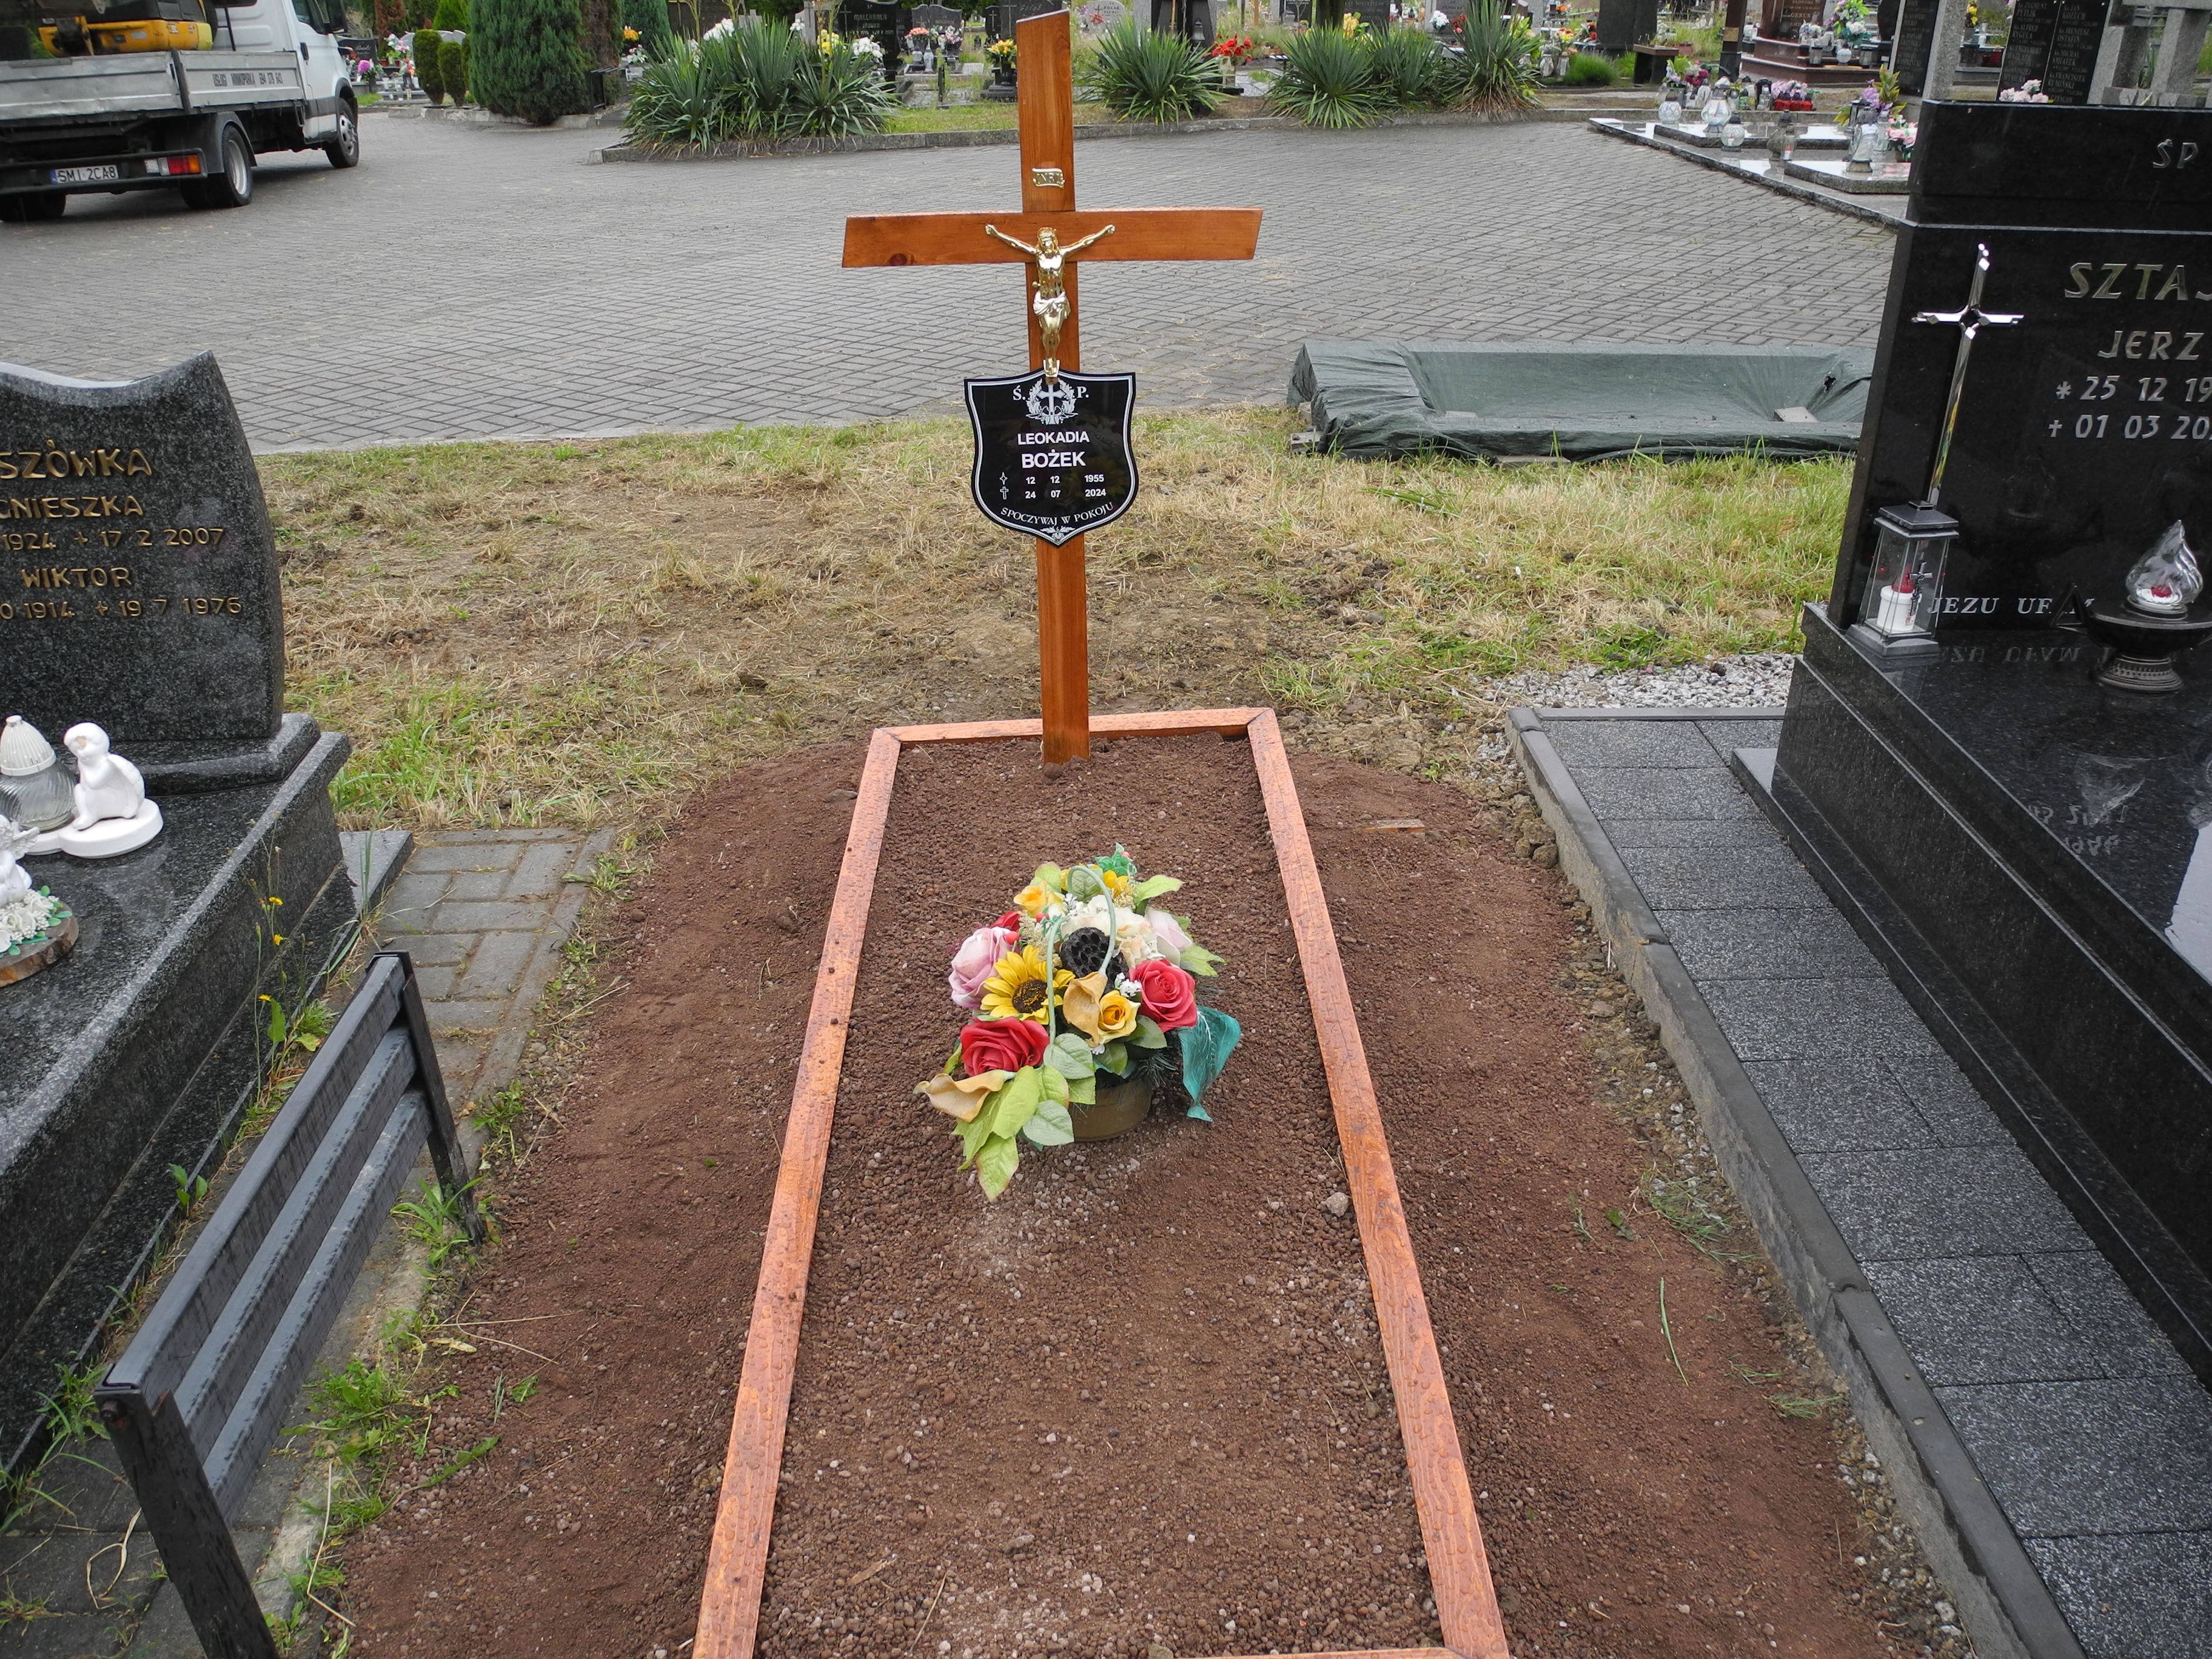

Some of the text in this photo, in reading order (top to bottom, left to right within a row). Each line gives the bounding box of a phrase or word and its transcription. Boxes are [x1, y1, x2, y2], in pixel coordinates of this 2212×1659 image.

[1013, 385, 1090, 401] Ś. P.
[2079, 375, 2120, 401] 25
[2137, 377, 2168, 401] 12
[2075, 414, 2110, 438] 01
[2124, 415, 2161, 439] 03
[1017, 431, 1090, 446] LEOKADIA
[1021, 448, 1087, 469] BOŻEK
[1025, 474, 1105, 485] 12 12 1955
[1025, 488, 1107, 499] 24 07 2024
[1000, 501, 1113, 526] SPOCZYWAJ W POKOJU
[99, 530, 122, 547] 17
[135, 529, 153, 546] 2
[163, 528, 224, 546] 2007
[21, 566, 132, 588] WIKTOR
[24, 601, 76, 619] 1914
[121, 599, 142, 617] 19
[152, 598, 167, 615] 7
[183, 596, 242, 614] 1976
[1927, 597, 2000, 614] JEZU
